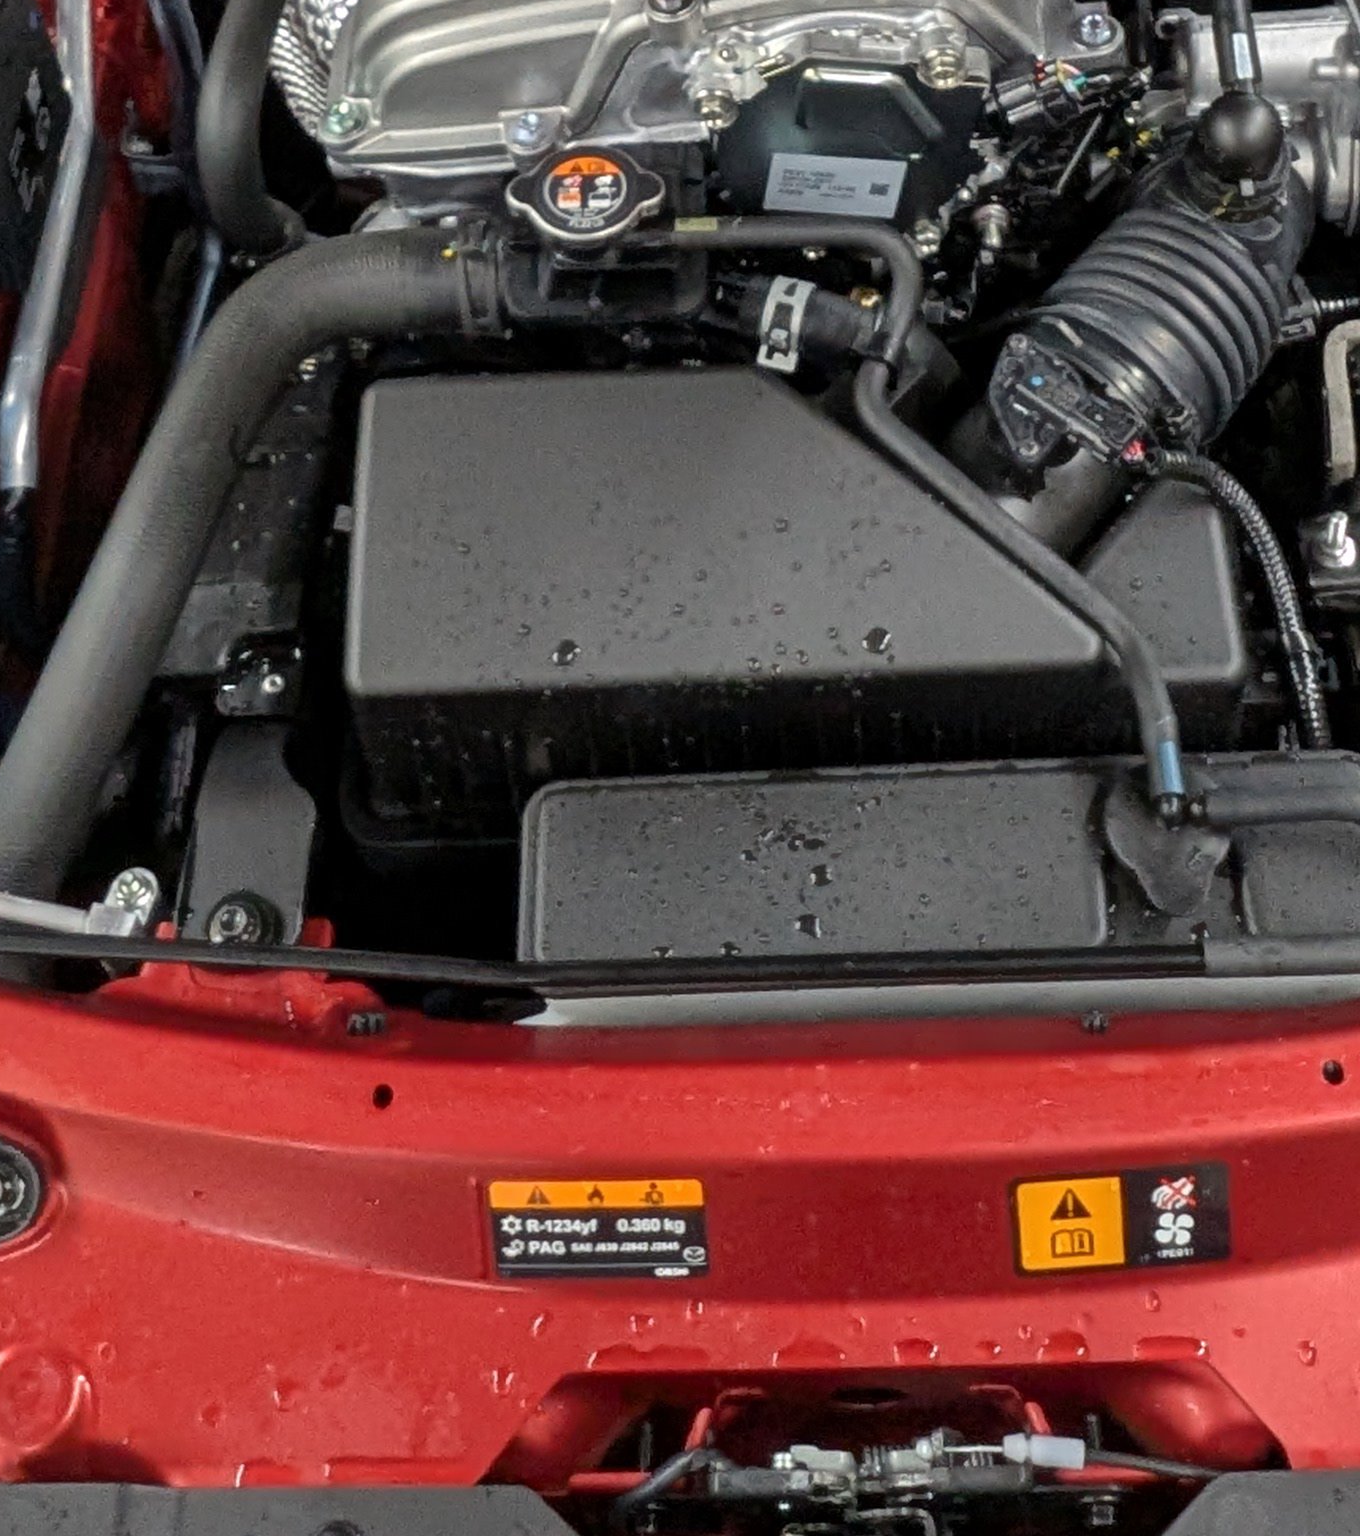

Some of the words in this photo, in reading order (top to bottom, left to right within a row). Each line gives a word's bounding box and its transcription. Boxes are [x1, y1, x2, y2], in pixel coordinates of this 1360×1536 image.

[525, 1218, 599, 1235] R-1234yf
[662, 1218, 686, 1234] kg
[528, 1240, 566, 1254] PAG
